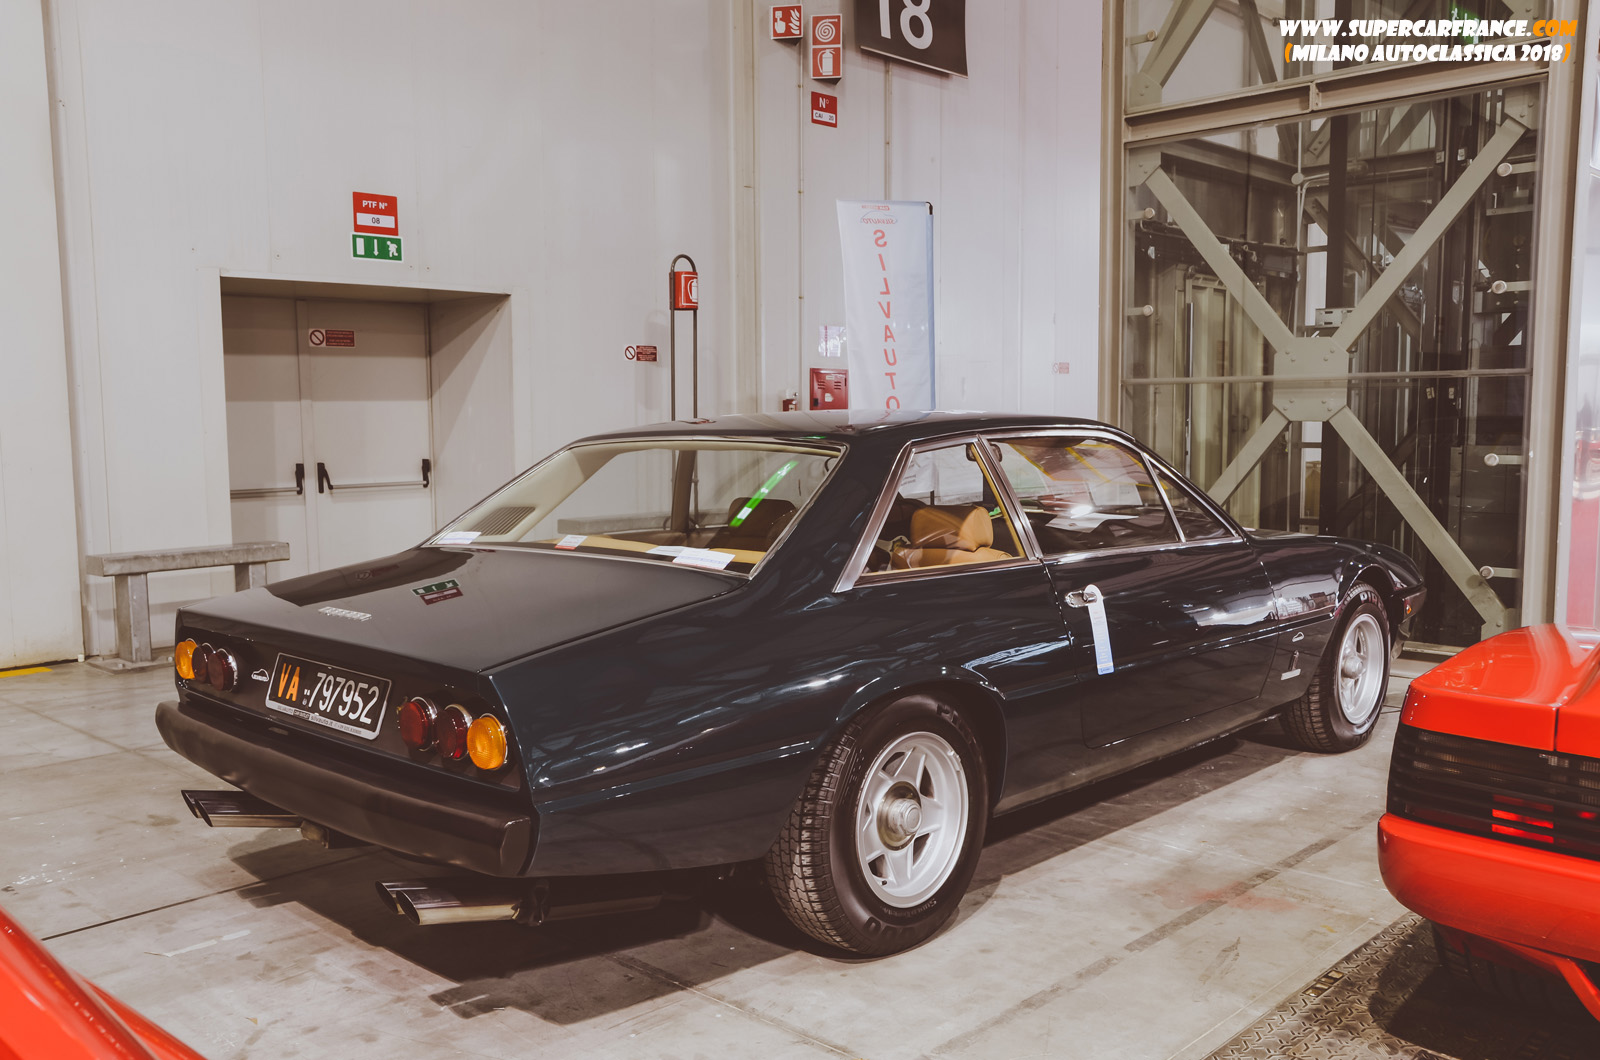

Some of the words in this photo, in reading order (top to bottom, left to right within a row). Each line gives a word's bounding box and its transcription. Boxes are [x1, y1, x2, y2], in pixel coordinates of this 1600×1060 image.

[362, 200, 377, 209] PTF
[371, 216, 381, 225] 08
[277, 662, 301, 702] VA
[308, 671, 380, 725] 797952
